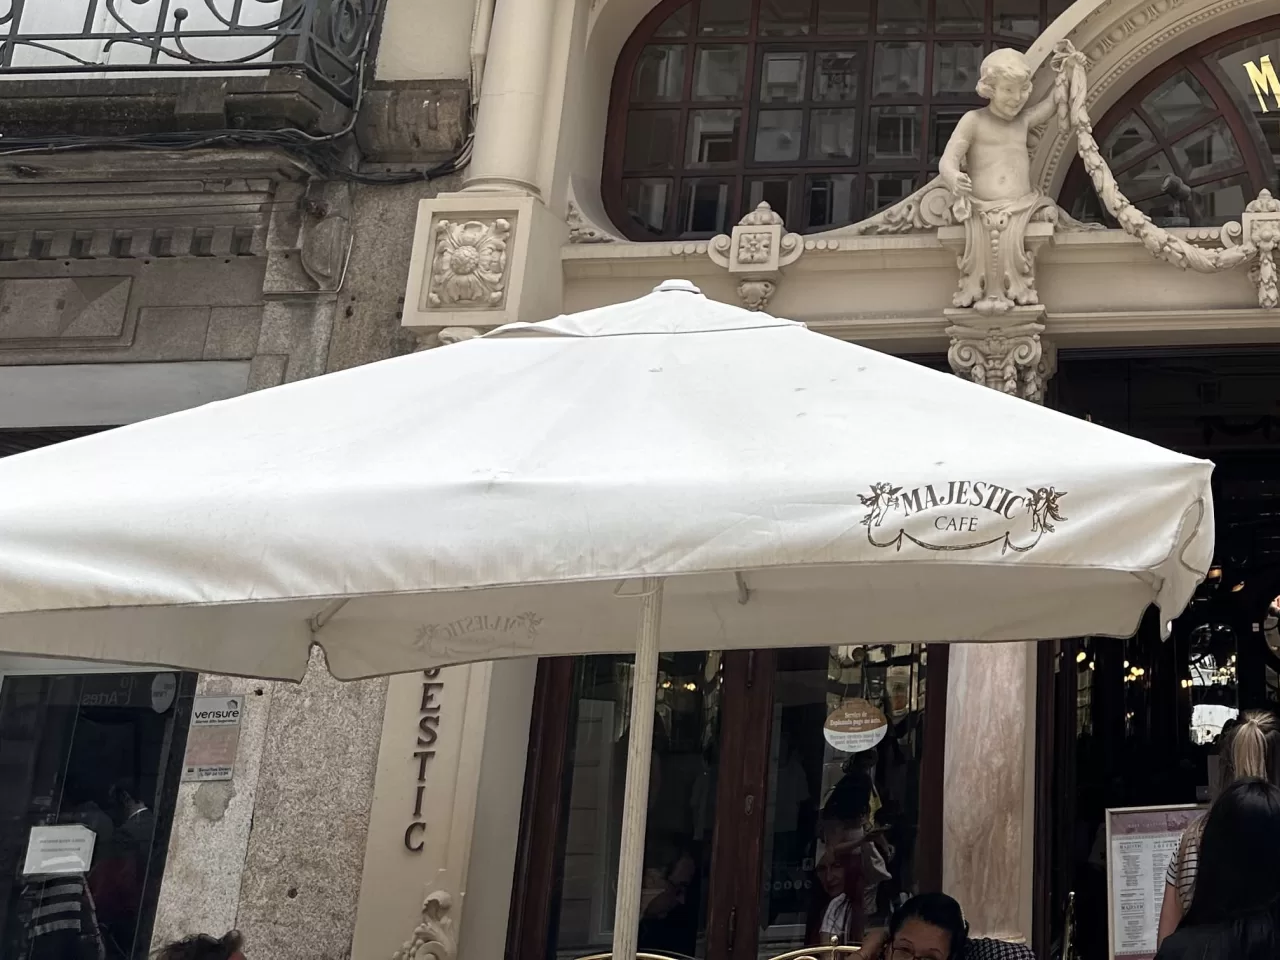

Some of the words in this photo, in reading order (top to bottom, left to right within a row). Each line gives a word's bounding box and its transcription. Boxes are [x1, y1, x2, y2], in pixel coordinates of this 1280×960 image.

[900, 480, 1026, 520] MAJESTIC
[934, 515, 979, 532] CAFÉ
[195, 710, 239, 719] verisure
